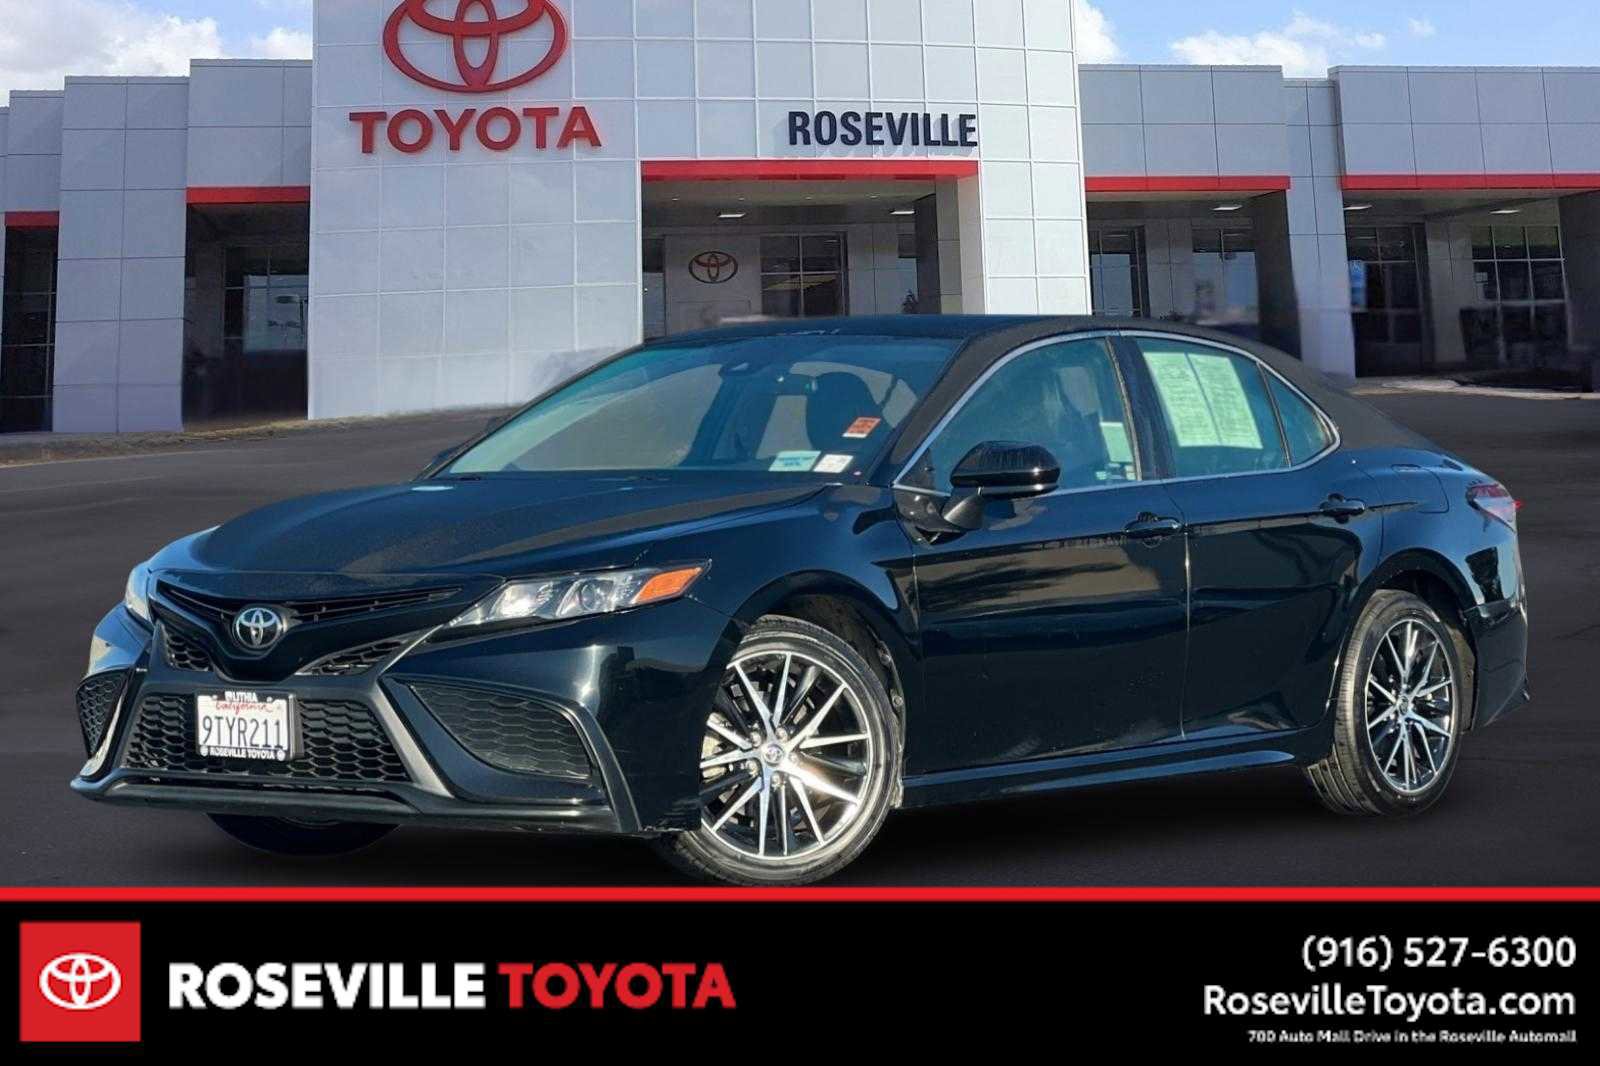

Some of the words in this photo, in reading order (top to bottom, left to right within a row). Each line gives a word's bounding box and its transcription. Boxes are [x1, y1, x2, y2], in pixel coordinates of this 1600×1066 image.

[349, 106, 602, 154] TOYOTA
[789, 111, 978, 147] ROSEVILLE
[202, 715, 284, 749] 9TYR211
[209, 746, 247, 759] ROSEVILLE
[247, 749, 276, 760] TOYOTA
